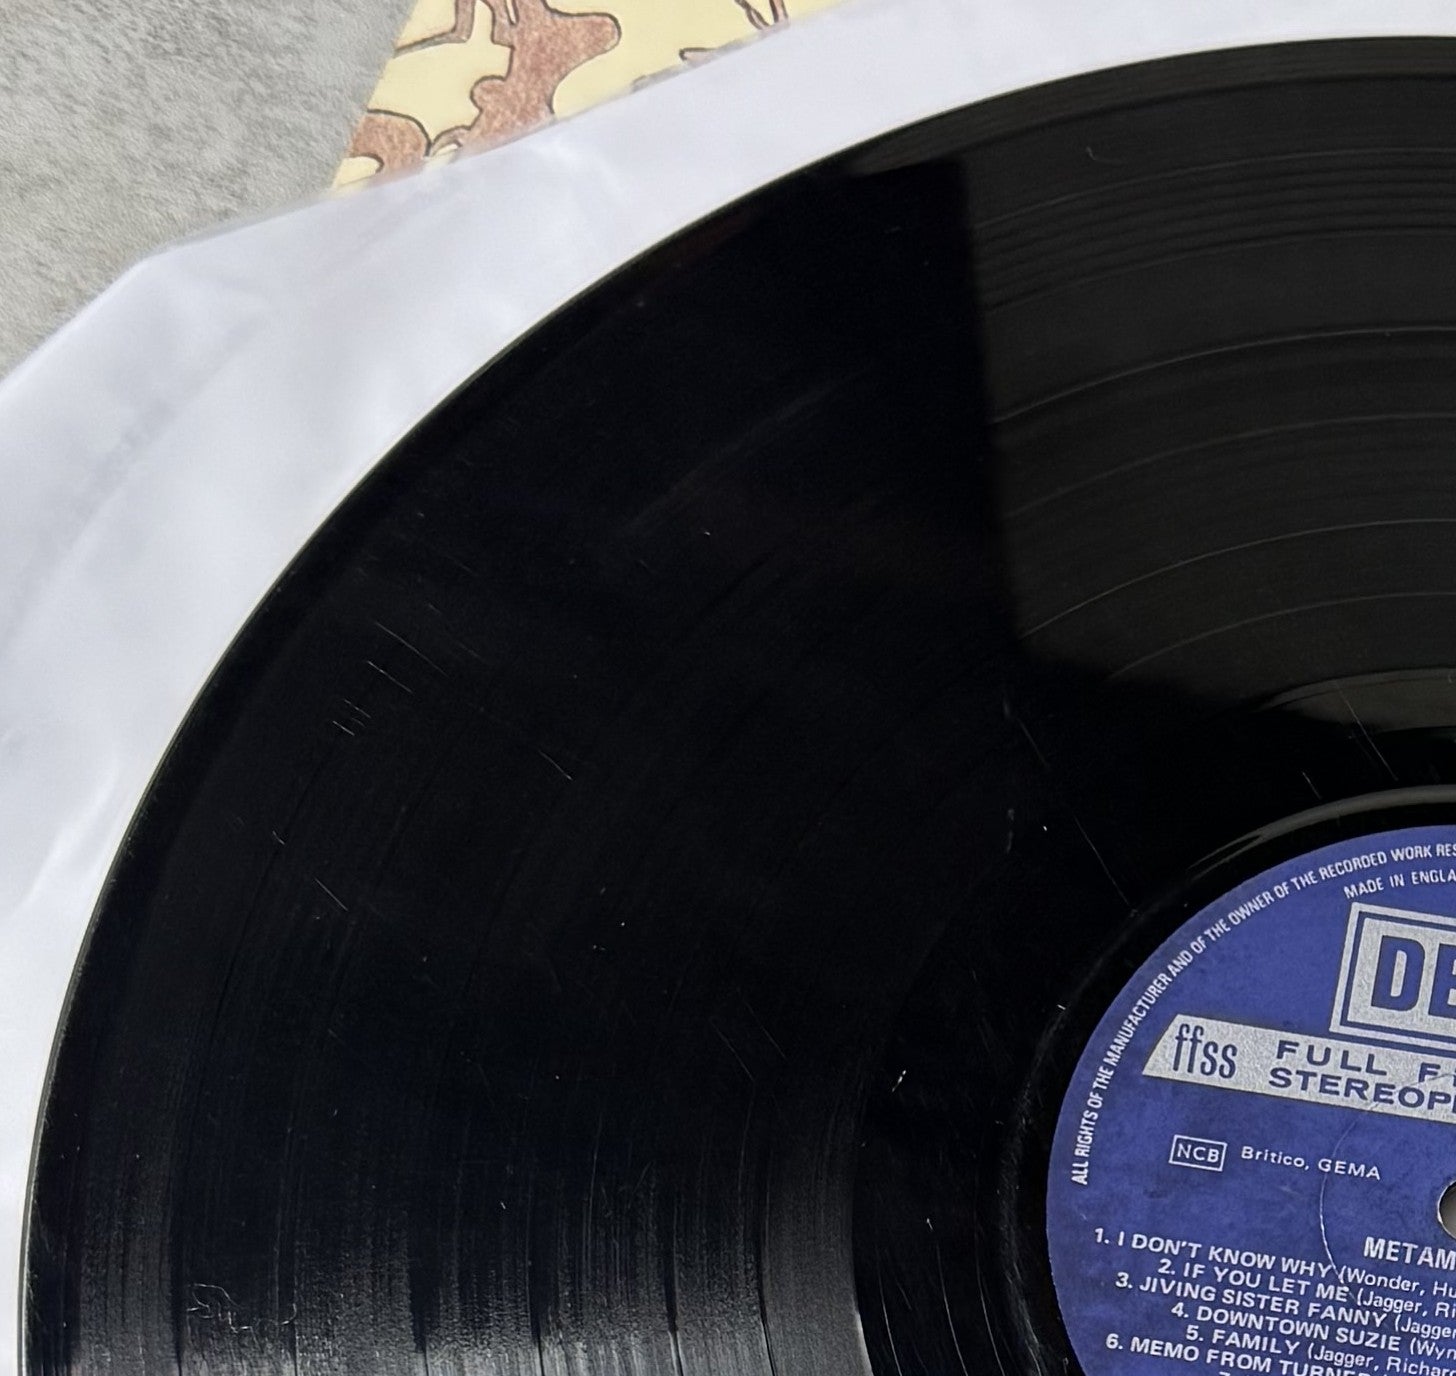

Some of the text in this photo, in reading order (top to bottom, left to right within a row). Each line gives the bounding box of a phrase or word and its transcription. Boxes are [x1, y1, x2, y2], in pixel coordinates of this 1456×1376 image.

[1319, 852, 1387, 880] RECORDED
[1391, 845, 1432, 861] WORK
[1274, 882, 1289, 898] OF
[1290, 871, 1318, 890] THE
[1344, 877, 1384, 898] MADE
[1390, 874, 1404, 887] IN
[1228, 891, 1274, 925] OWNER
[1190, 936, 1206, 953] OF
[1204, 919, 1231, 941] THE
[1167, 950, 1193, 977] AND
[1103, 973, 1172, 1066] MANUFACTURER
[1276, 1040, 1387, 1076] FULL
[1093, 1066, 1114, 1089] THE
[1087, 1092, 1103, 1108] OF
[1074, 1110, 1098, 1157] RIGHTS
[1071, 1161, 1088, 1185] ALL
[1176, 1143, 1380, 1180] NCB Britico, GEMA
[1095, 1228, 1109, 1244] 1.
[1118, 1231, 1124, 1246] I
[1132, 1234, 1202, 1258] DON'T
[1208, 1246, 1276, 1269] KNOW
[1282, 1257, 1332, 1278] WHY
[1338, 1266, 1425, 1296] (Wonder,
[1116, 1272, 1132, 1288] 3.
[1140, 1277, 1216, 1301] JIVING
[1222, 1289, 1299, 1314] SISTER
[1308, 1303, 1387, 1327] FANNY
[1158, 1258, 1175, 1275] 2.
[1184, 1263, 1205, 1278] IF
[1214, 1266, 1261, 1287] YOU
[1269, 1276, 1311, 1295] LET
[1316, 1283, 1349, 1302] ME
[1357, 1288, 1427, 1317] (Jagger,
[1171, 1302, 1189, 1318] 4.
[1197, 1306, 1329, 1340] DOWNTOWN
[1336, 1328, 1401, 1351] SUZIE
[1106, 1333, 1123, 1349] 6.
[1130, 1337, 1199, 1361] MEMO
[1206, 1349, 1271, 1372] FROM
[1186, 1325, 1203, 1341] 5.
[1212, 1329, 1300, 1355] FAMILY
[1308, 1343, 1379, 1371] (Jagger,
